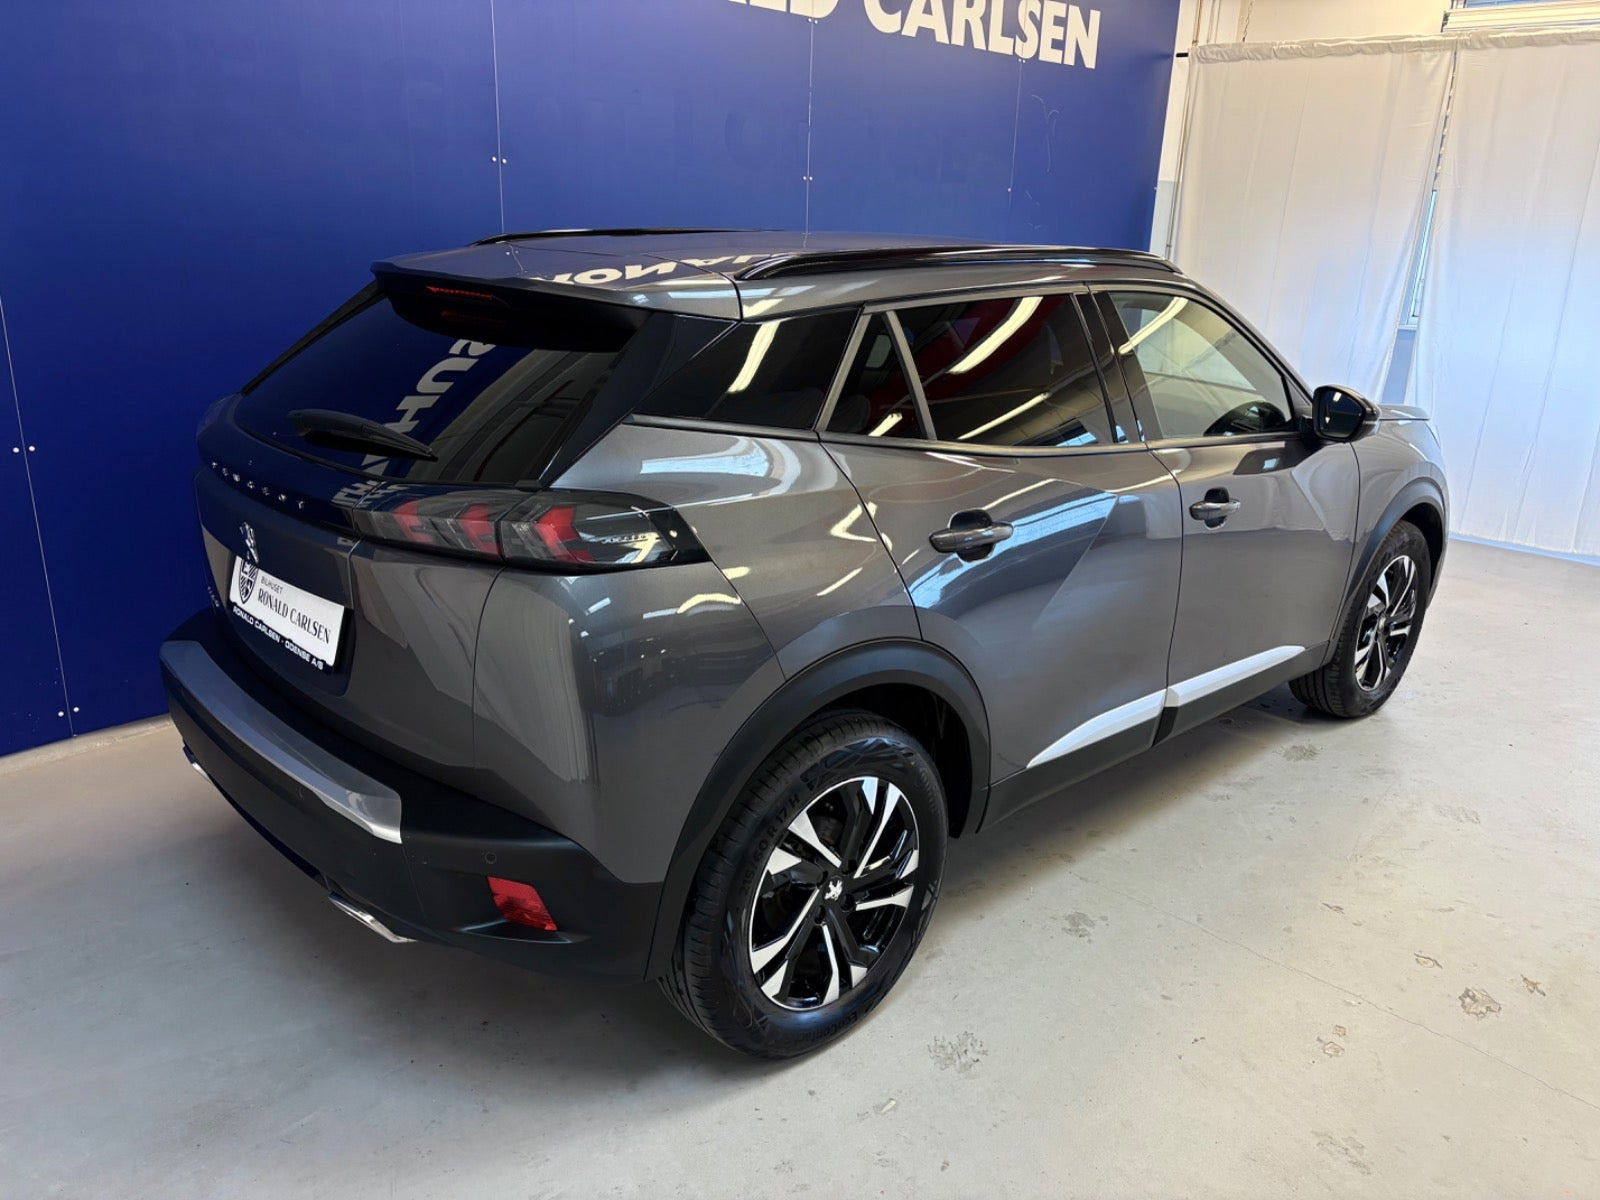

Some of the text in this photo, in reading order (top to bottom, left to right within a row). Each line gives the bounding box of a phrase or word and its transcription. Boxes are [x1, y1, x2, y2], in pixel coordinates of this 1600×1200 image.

[864, 0, 1100, 69] CARLSEN
[233, 605, 254, 625] RONALD
[254, 620, 281, 643] CARLSEN
[258, 587, 289, 618] RONALD
[289, 607, 331, 644] CARLSEN
